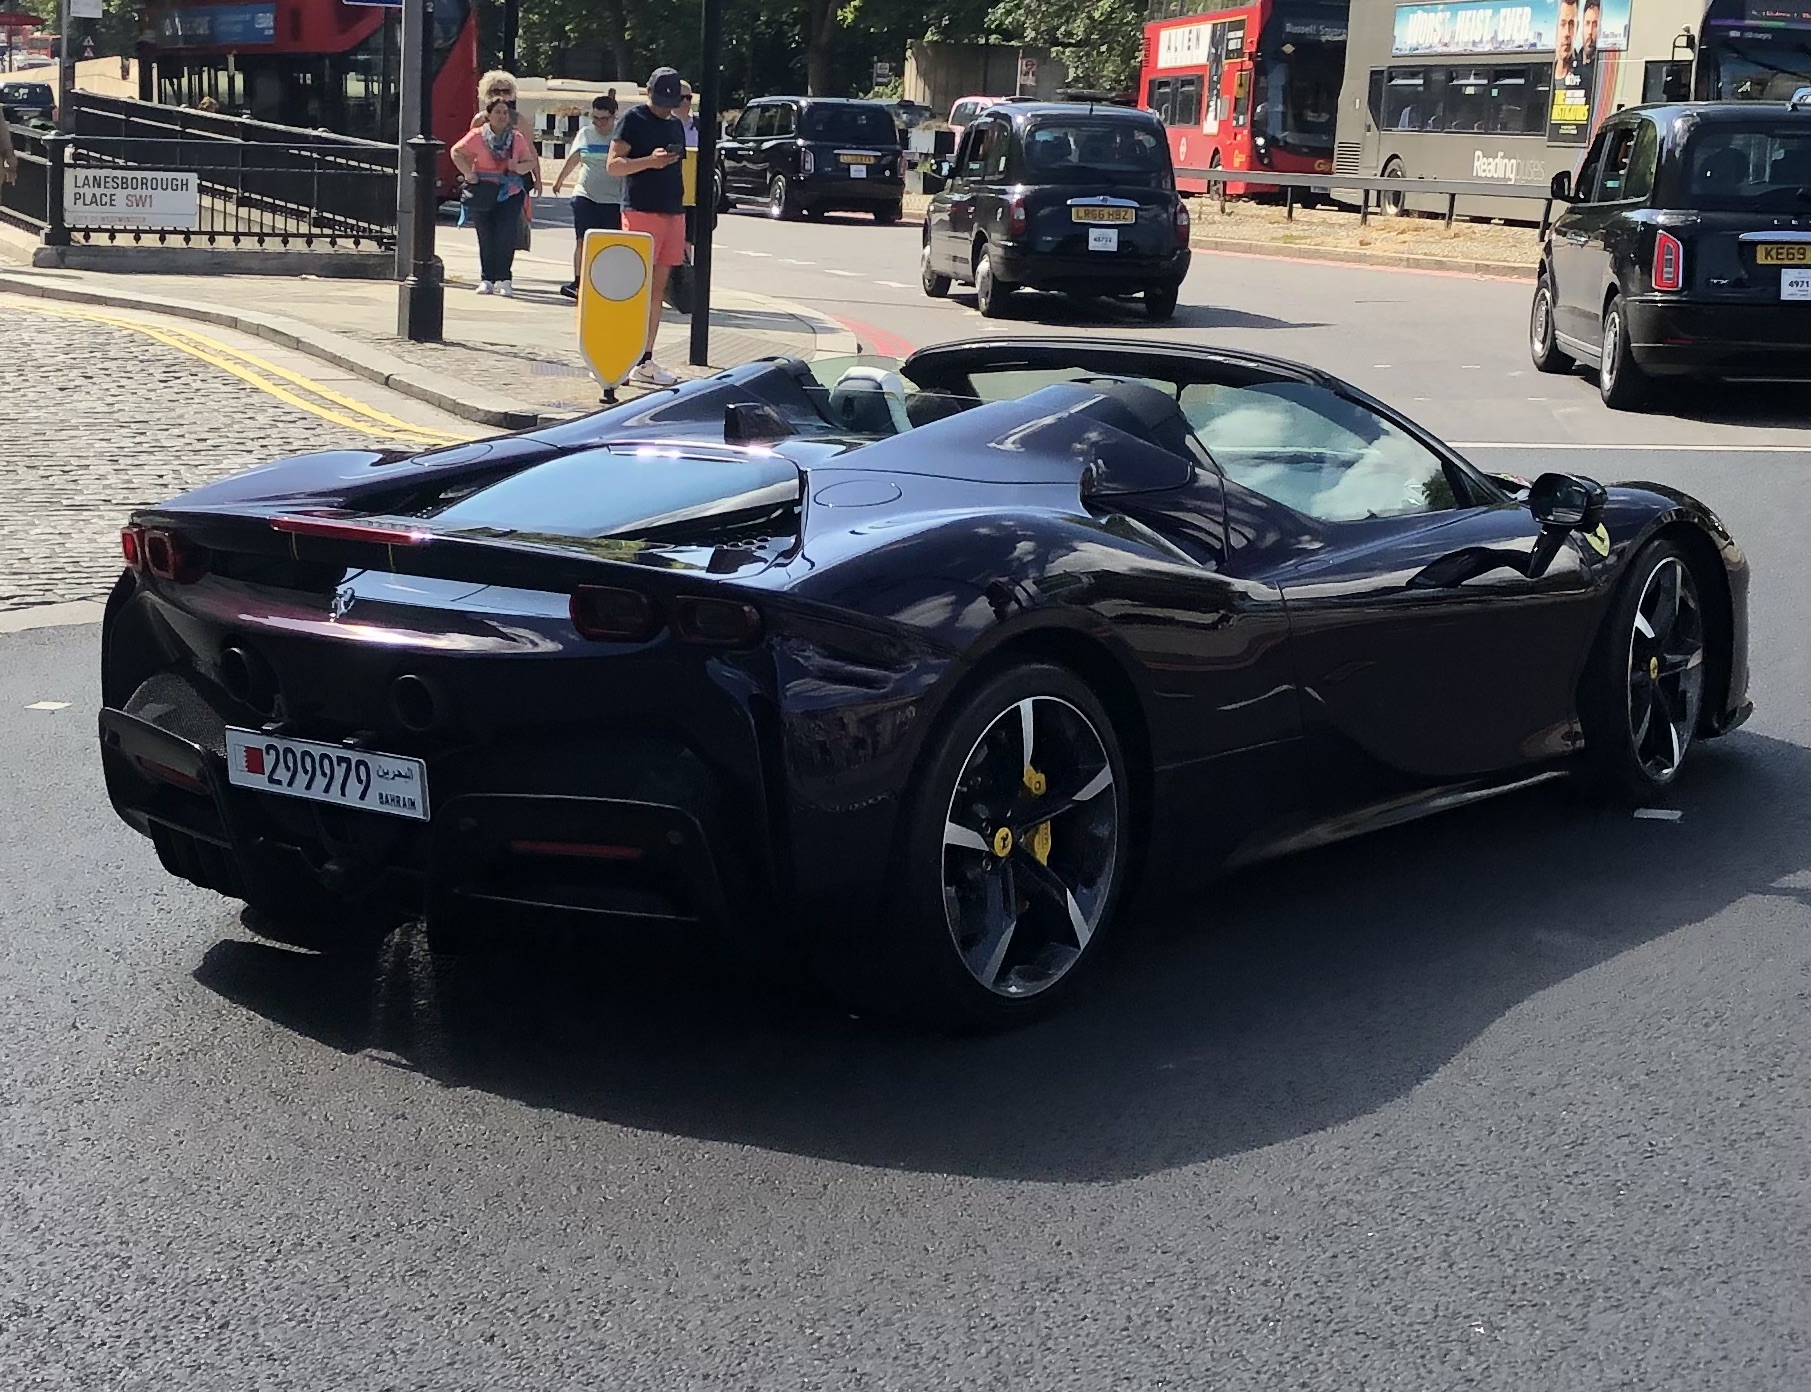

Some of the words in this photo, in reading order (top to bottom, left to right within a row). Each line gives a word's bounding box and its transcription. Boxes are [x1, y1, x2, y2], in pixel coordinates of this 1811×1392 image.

[1498, 7, 1531, 41] EVER
[74, 174, 189, 192] LANESBOROUGH
[73, 192, 117, 207] PLACE
[125, 193, 153, 208] SW1
[1764, 246, 1807, 261] KE69
[264, 743, 371, 801] 299979
[376, 764, 414, 784] البحرين
[378, 792, 417, 811] BAHRAIN
